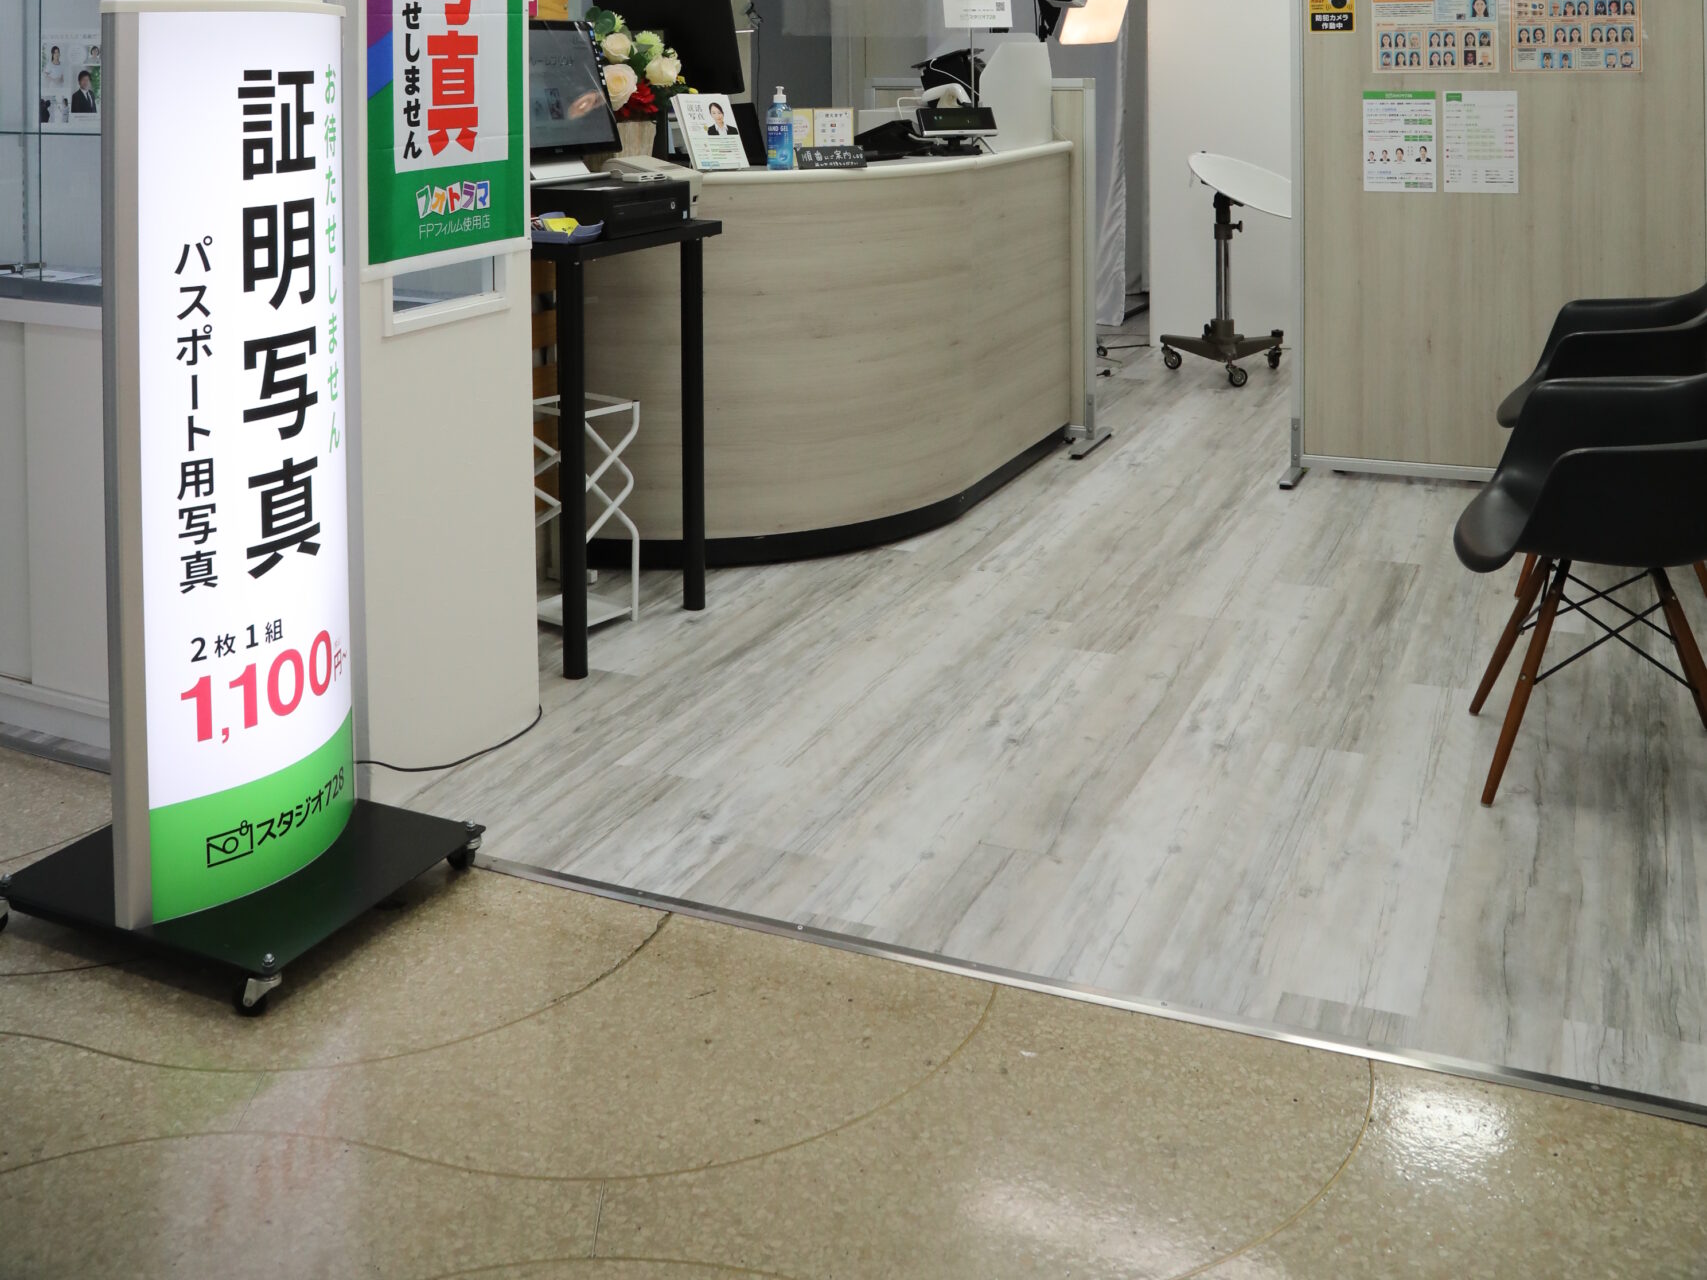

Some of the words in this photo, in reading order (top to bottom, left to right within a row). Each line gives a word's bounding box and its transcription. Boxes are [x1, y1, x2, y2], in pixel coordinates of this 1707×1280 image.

[1315, 14, 1348, 22] 防犯カメラ
[1321, 22, 1343, 30] 作動中
[324, 63, 340, 454] お待たせしません
[419, 215, 490, 240] FPフィルム使用店
[238, 69, 321, 580] 証明写真
[175, 234, 219, 594] パスポート用写真
[190, 619, 283, 663] 2枚1組
[256, 766, 344, 846] スタジオ728
